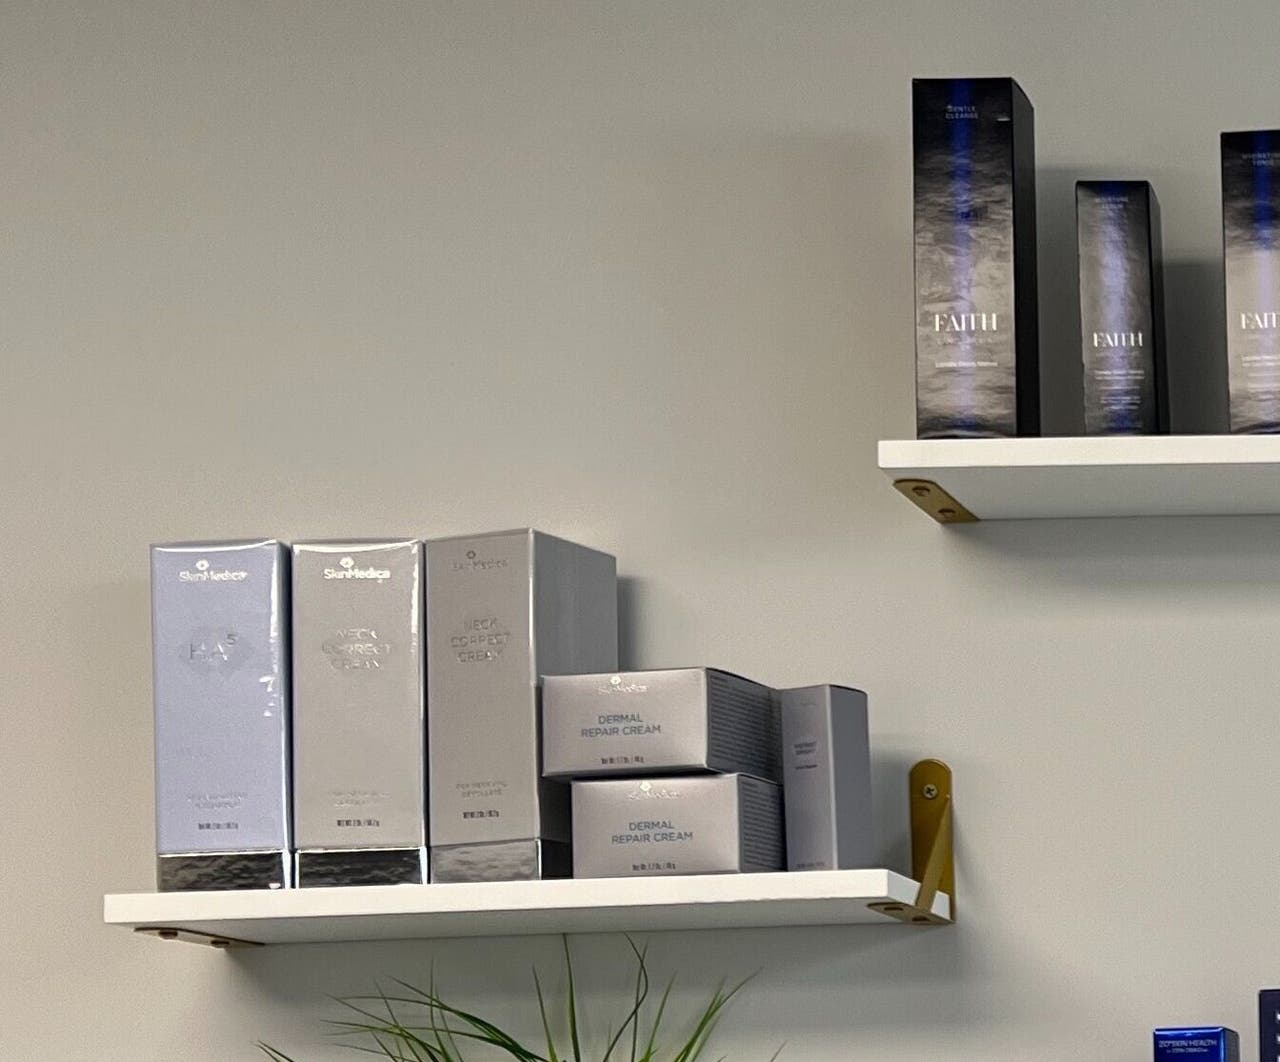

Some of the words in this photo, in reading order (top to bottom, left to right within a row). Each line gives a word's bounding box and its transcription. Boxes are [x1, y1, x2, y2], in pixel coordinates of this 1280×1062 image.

[935, 313, 998, 332] FAITH
[1093, 332, 1144, 348] FAITH
[598, 713, 644, 725] DERMAL
[581, 727, 619, 738] REPAIR
[622, 725, 661, 736] CREAM
[628, 820, 675, 832] DERMAL
[611, 833, 650, 845] REPAIR
[653, 831, 694, 842] CREAM
